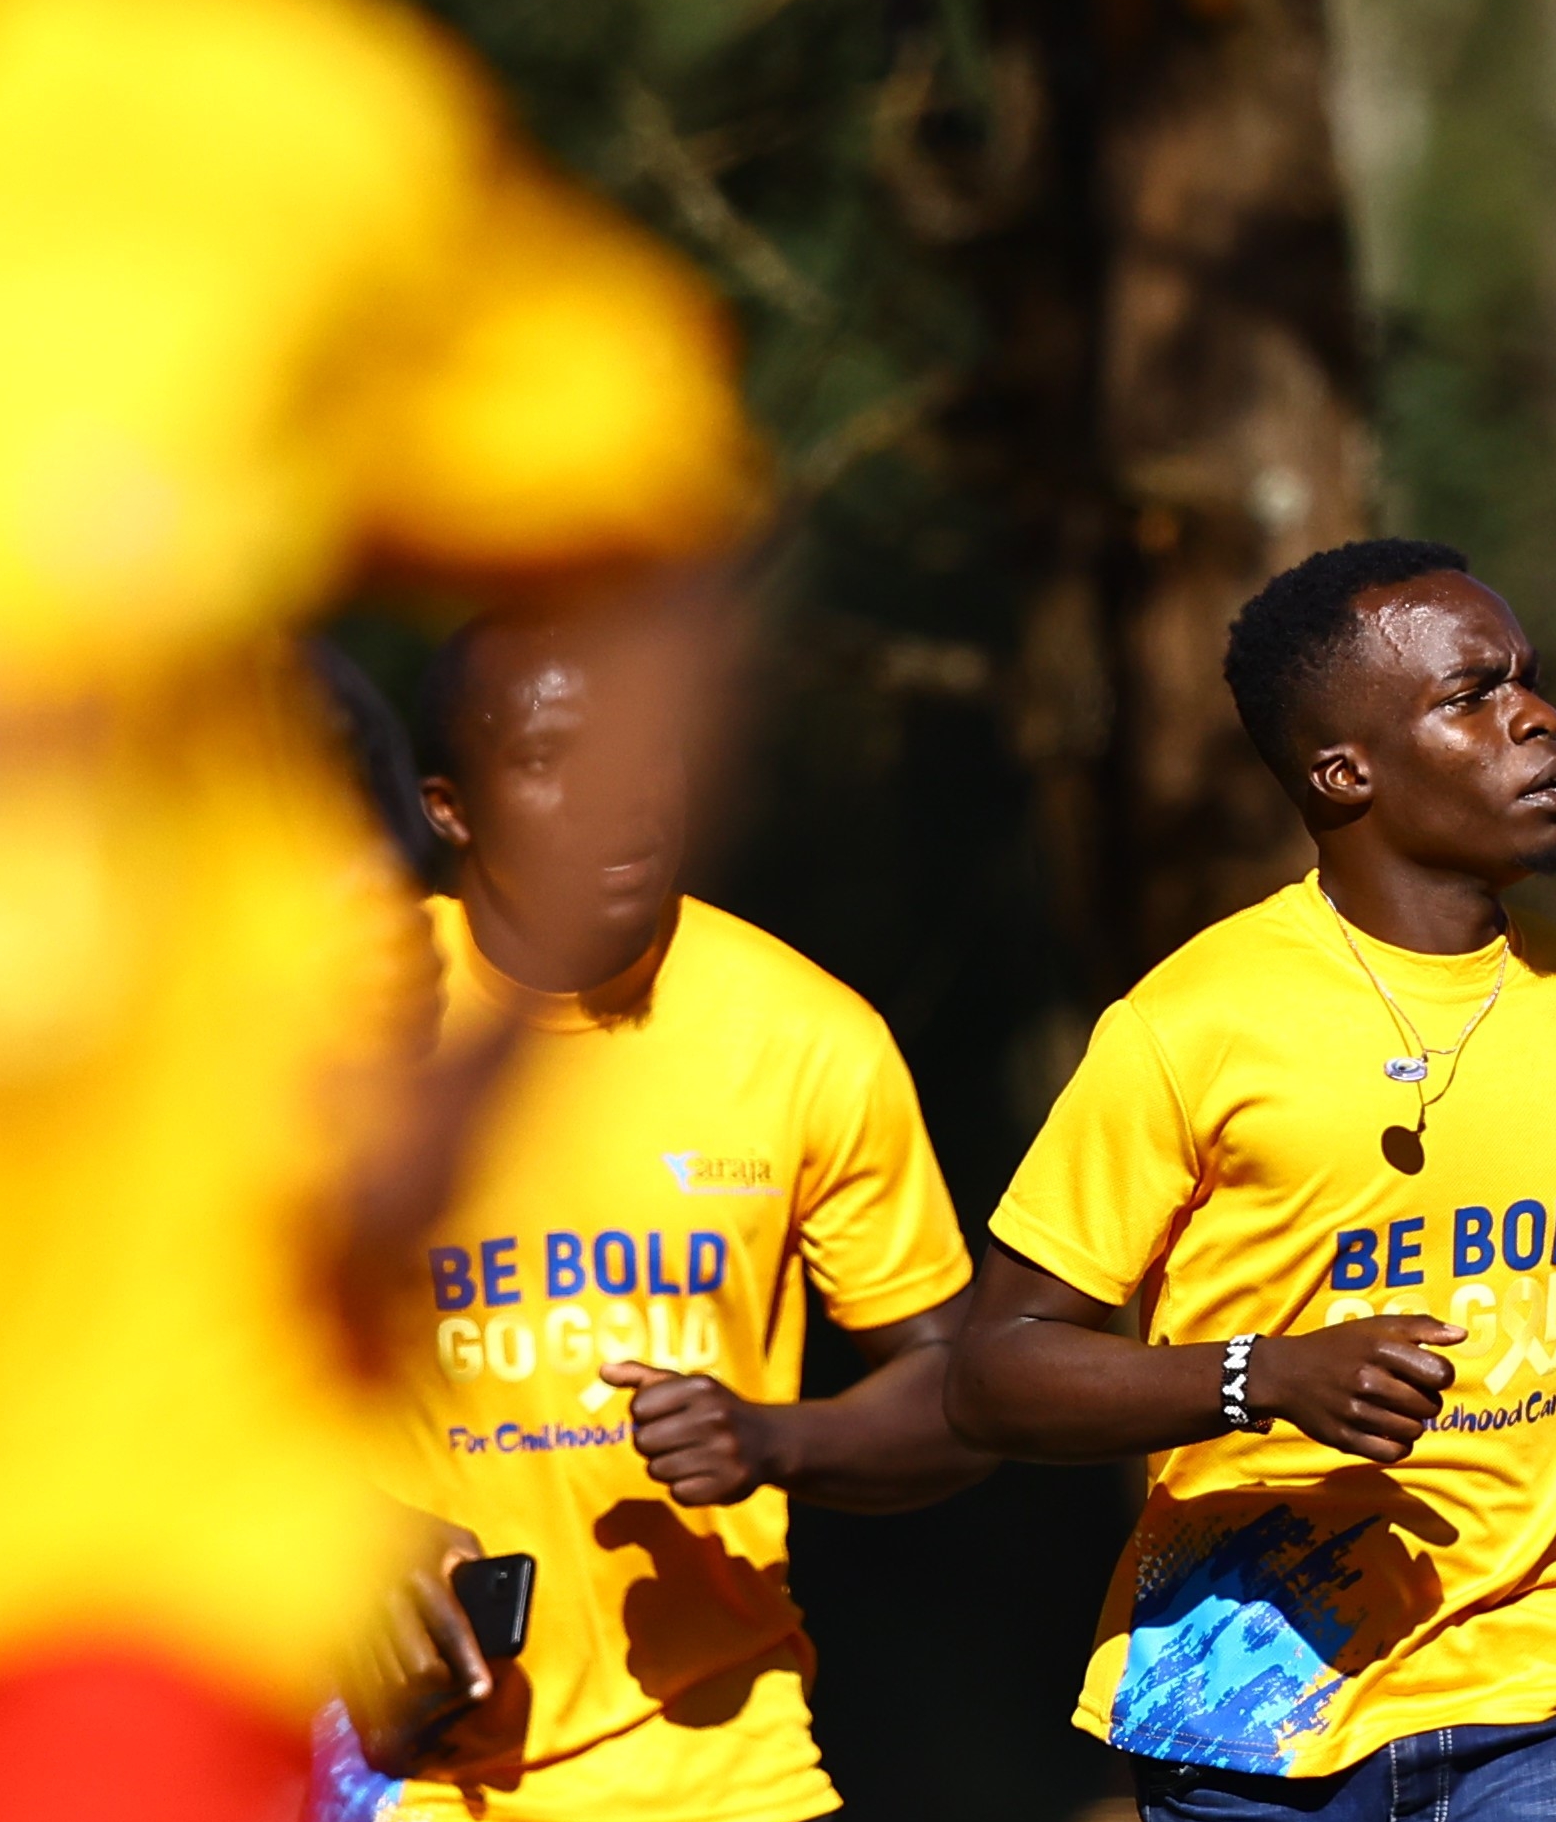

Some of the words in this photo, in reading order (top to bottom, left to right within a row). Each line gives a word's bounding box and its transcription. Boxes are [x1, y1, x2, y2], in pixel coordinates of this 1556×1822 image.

[429, 1236, 522, 1311] BE
[545, 1229, 726, 1298] BOLD
[1330, 1217, 1425, 1290] BE
[436, 1316, 538, 1382] GO
